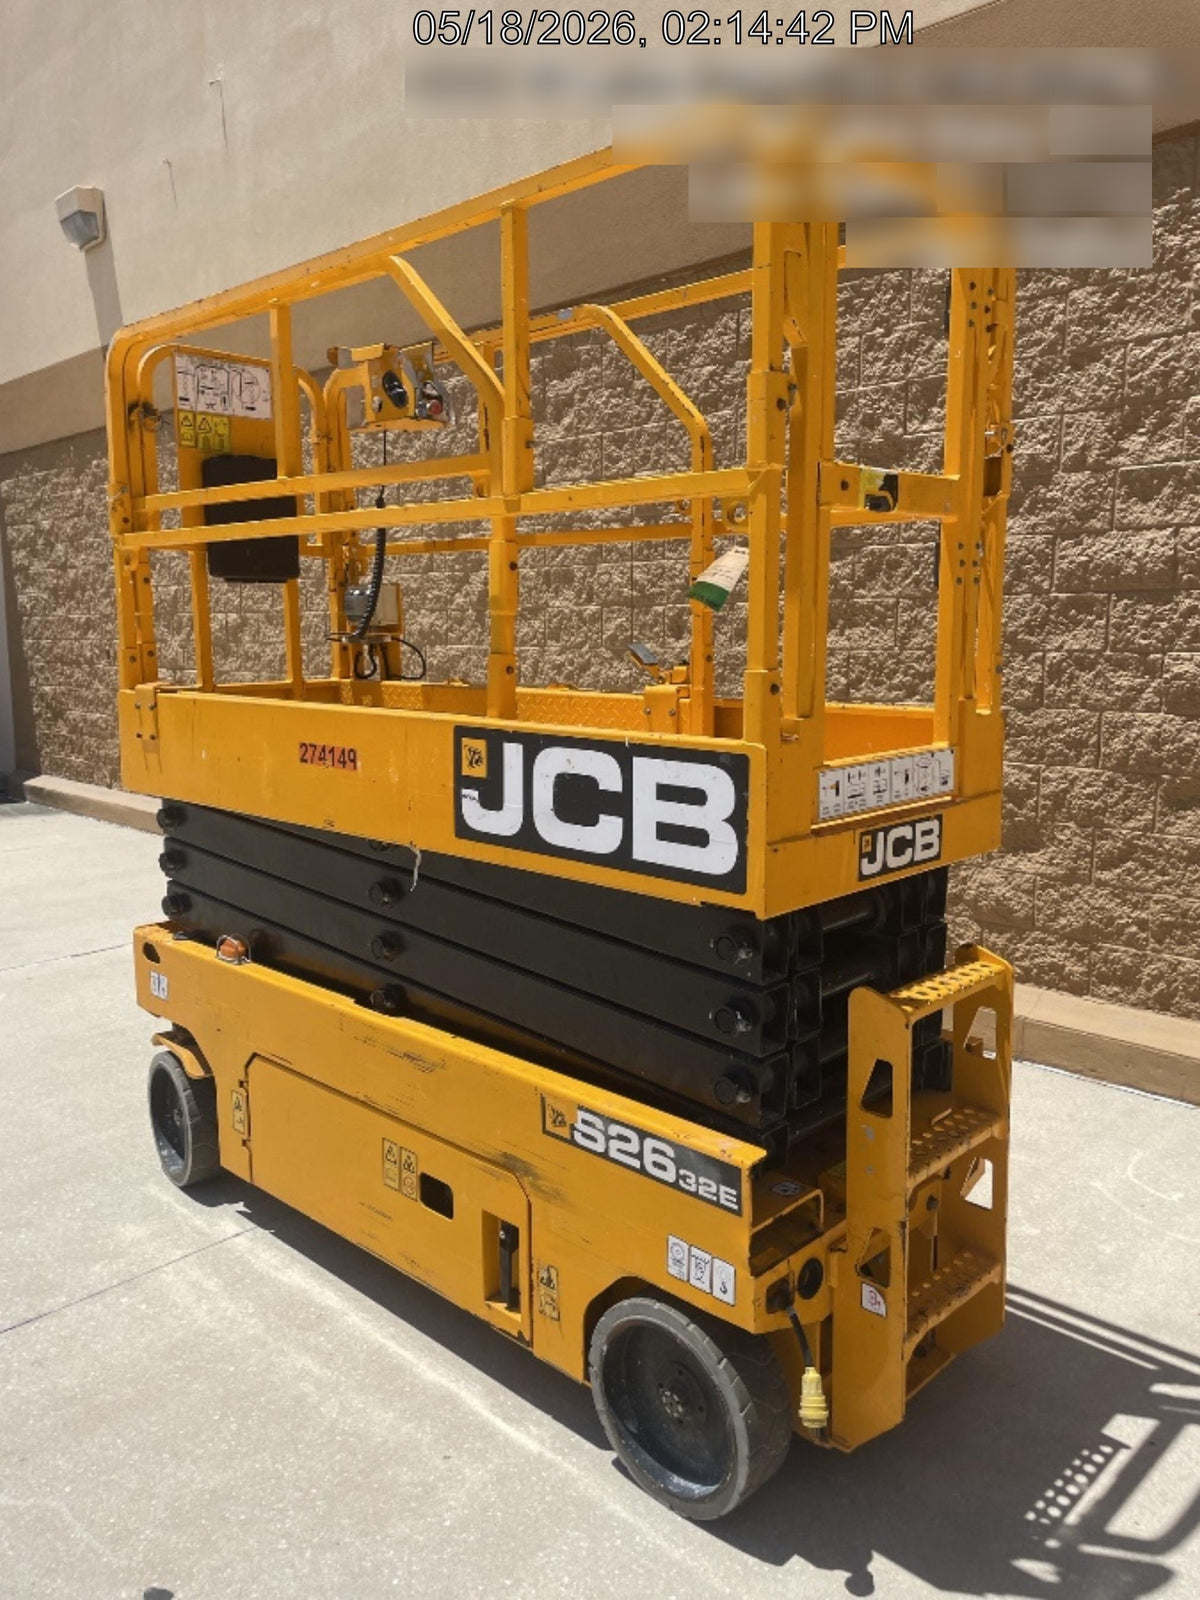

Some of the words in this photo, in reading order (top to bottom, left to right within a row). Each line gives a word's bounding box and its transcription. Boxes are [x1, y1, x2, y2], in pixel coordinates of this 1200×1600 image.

[299, 742, 357, 770] 274149
[461, 742, 739, 875] JCB
[861, 819, 940, 876] JCB
